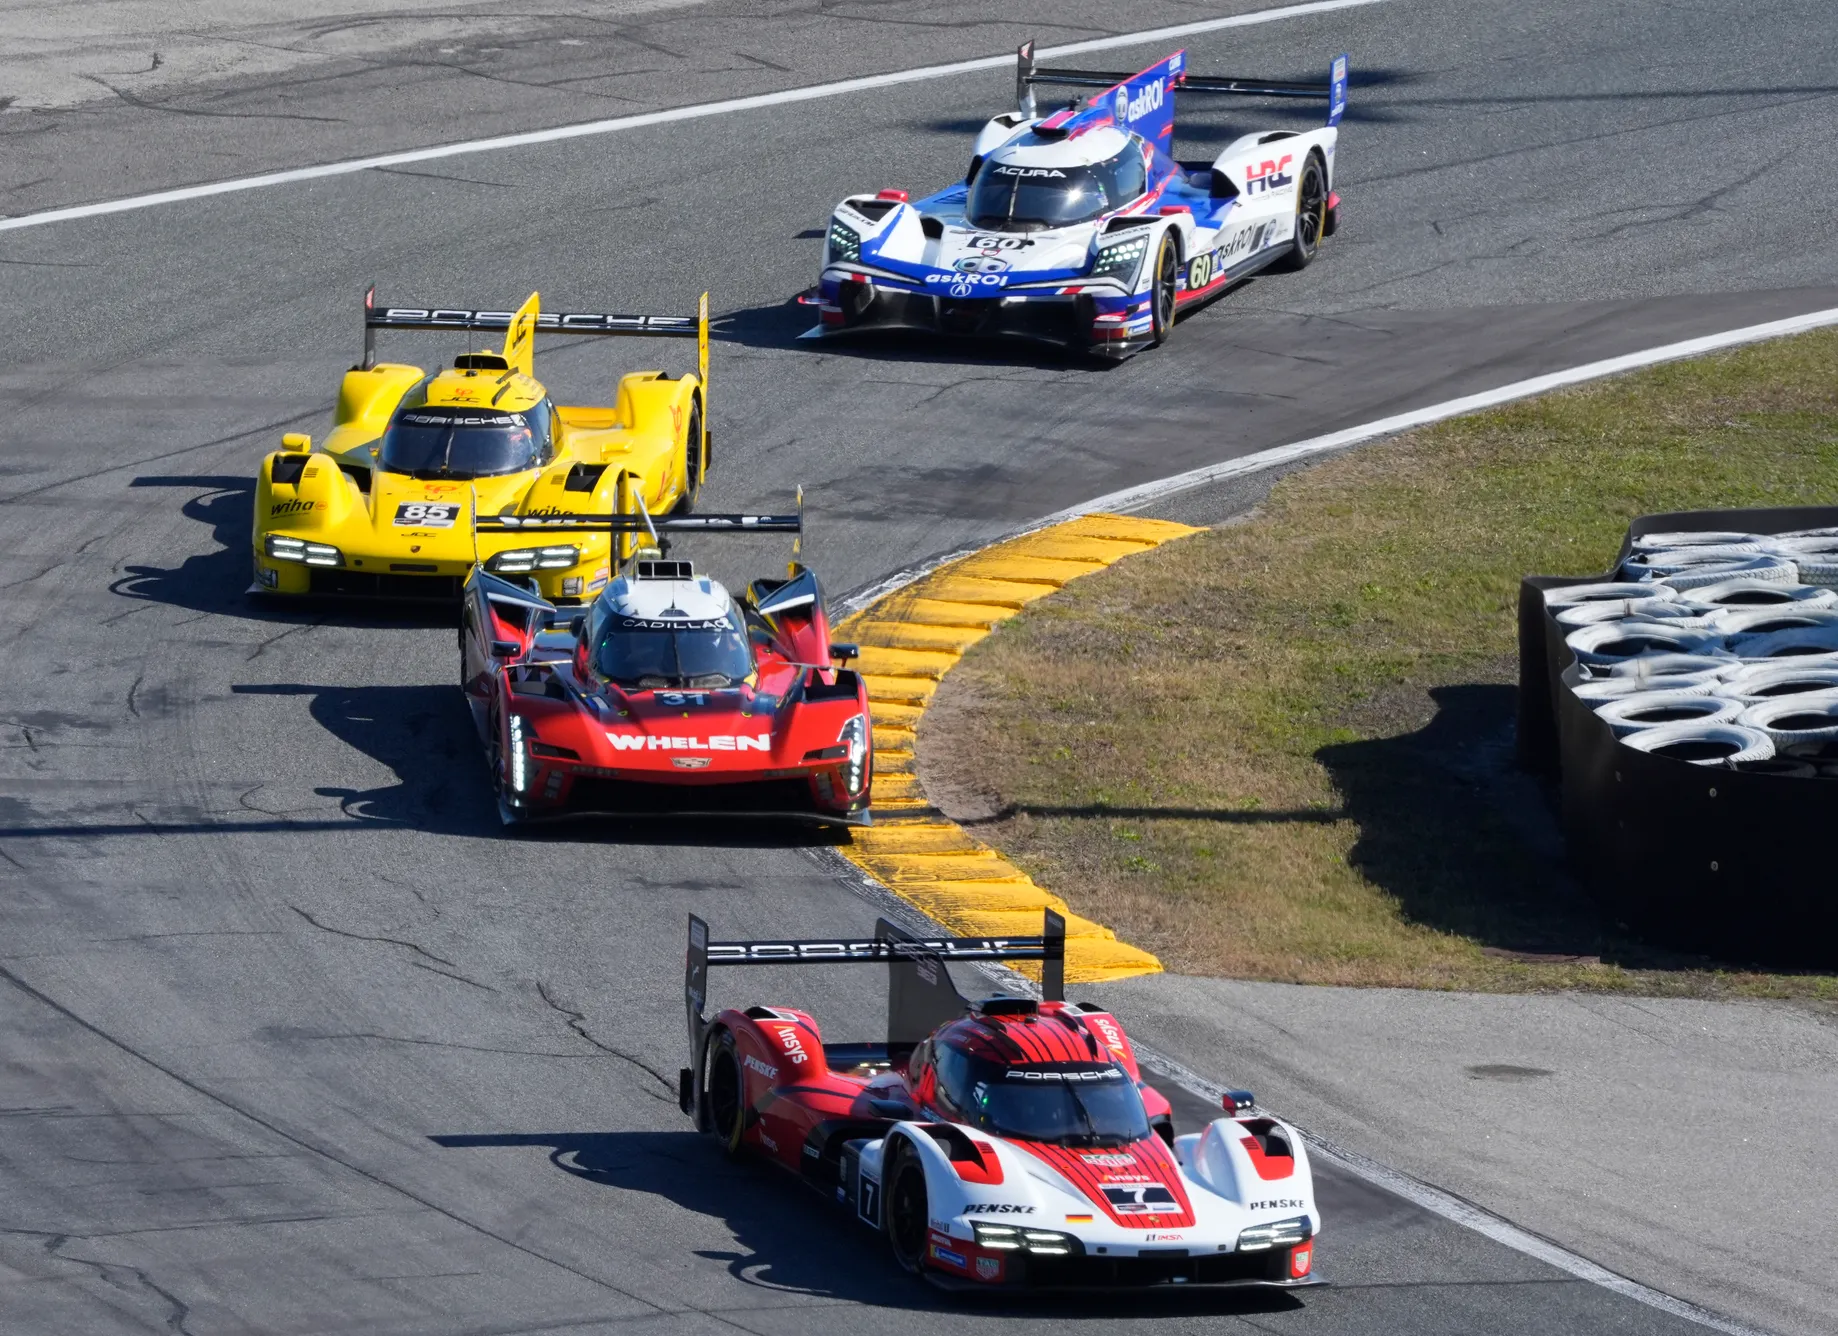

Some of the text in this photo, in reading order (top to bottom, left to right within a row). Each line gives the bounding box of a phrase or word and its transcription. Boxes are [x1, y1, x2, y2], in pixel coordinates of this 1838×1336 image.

[993, 166, 1067, 178] ACURA
[1246, 154, 1292, 196] HRC
[976, 237, 1021, 249] 60
[1190, 254, 1210, 289] 60
[925, 273, 1009, 286] askROI
[386, 308, 691, 330] PORSCHE
[403, 414, 513, 425] PORSCHE
[271, 498, 315, 516] wiha
[404, 506, 449, 520] 85
[622, 619, 729, 629] CADILLAC
[662, 693, 704, 706] 31
[605, 732, 771, 751] WHELEN
[773, 1025, 809, 1064] Ansys
[744, 1055, 779, 1079] PENSKE
[1005, 1068, 1122, 1081] PORSCHE
[865, 1183, 875, 1216] 7
[1121, 1187, 1146, 1203] 7
[962, 1204, 1038, 1215] PENSKE
[1250, 1200, 1305, 1211] PENSKE
